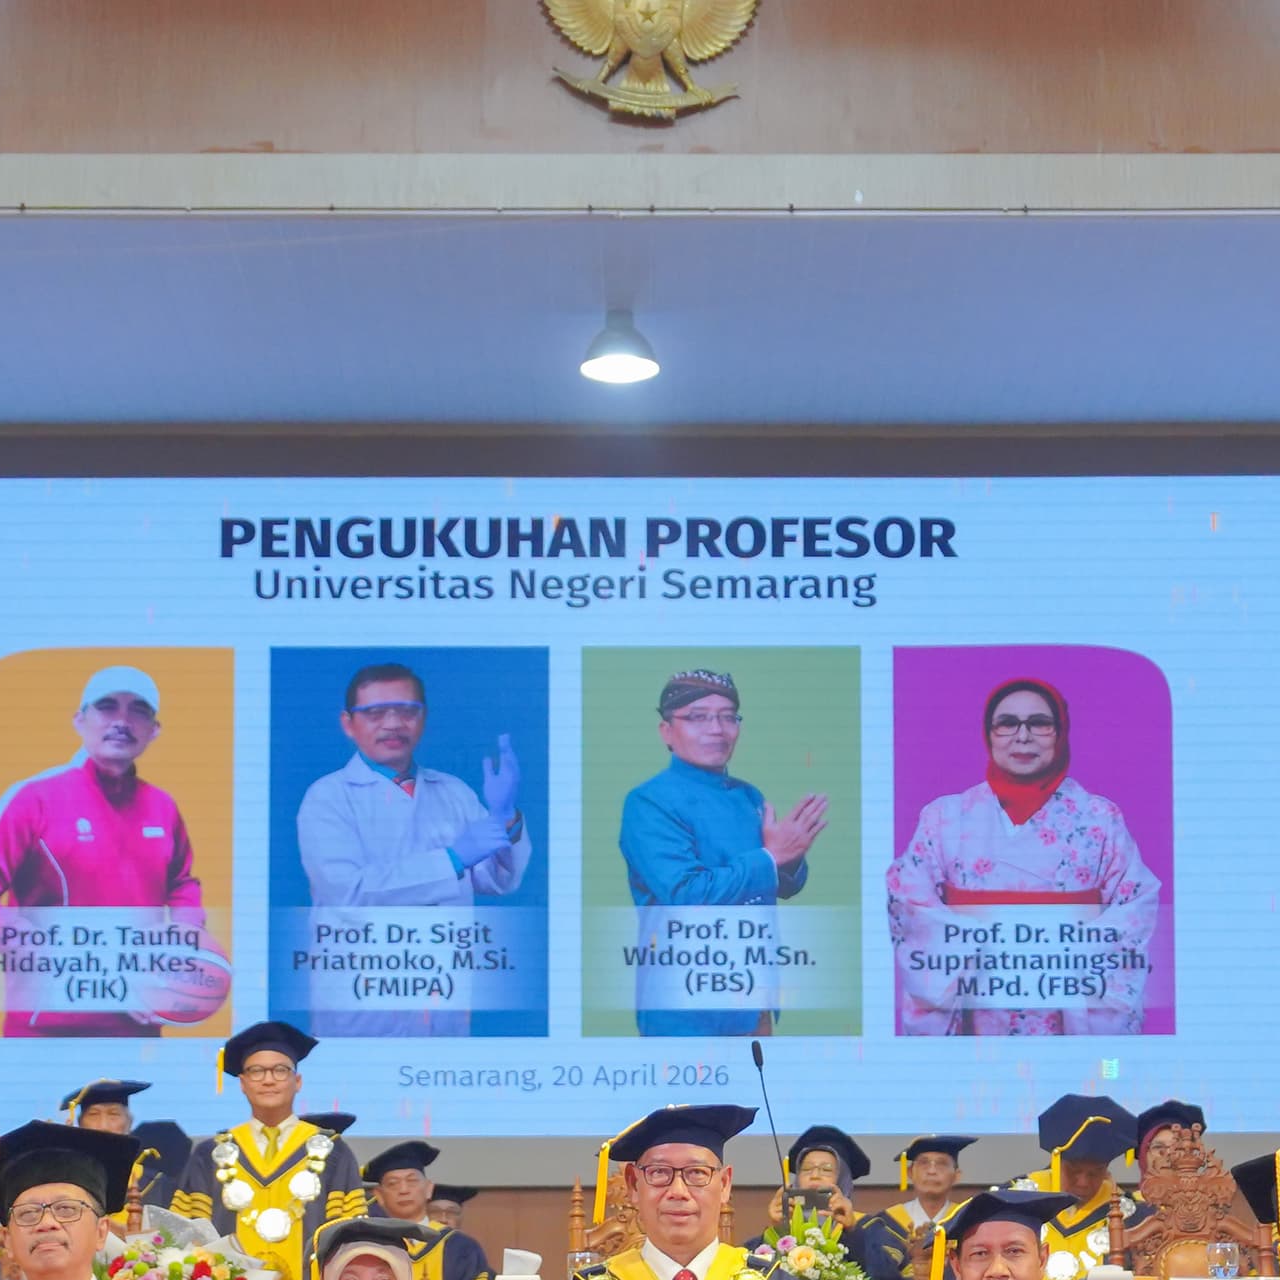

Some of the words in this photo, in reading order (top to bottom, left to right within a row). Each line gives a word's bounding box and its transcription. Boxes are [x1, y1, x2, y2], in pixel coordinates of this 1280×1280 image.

[220, 516, 626, 559] PENGUKUHAN
[646, 516, 958, 559] PROFESOR
[254, 566, 495, 601] Universitas
[510, 566, 647, 608] Negeri
[662, 568, 877, 608] Semarang
[1, 926, 62, 946] Prof.
[73, 927, 107, 946] Dr.
[117, 926, 199, 951] Taufiq
[316, 922, 377, 944] Prof.
[387, 924, 420, 944] Dr.
[430, 921, 492, 949] Sigit
[667, 919, 728, 939] Prof.
[738, 920, 772, 939] Dr.
[944, 922, 1005, 944] Prof.
[1015, 924, 1048, 944] Dr.
[1060, 921, 1118, 943] Rina
[117, 953, 205, 973] M.Kes.
[292, 949, 443, 973] Priatmoko,
[452, 949, 515, 970] M.Si.
[623, 944, 735, 970] Widodo,
[744, 946, 816, 966] M.Sn.
[909, 948, 1153, 976] Supriatnaningsih,
[65, 977, 128, 1001] (FIK)
[353, 974, 454, 1000] (FMIPA)
[685, 969, 755, 995] (FBS)
[956, 975, 1029, 997] M.Pd.
[1038, 974, 1107, 1000] (FBS)
[398, 1065, 543, 1091] Semarang,
[552, 1065, 583, 1086] 20
[593, 1064, 657, 1090] April
[667, 1064, 730, 1086] 2026
